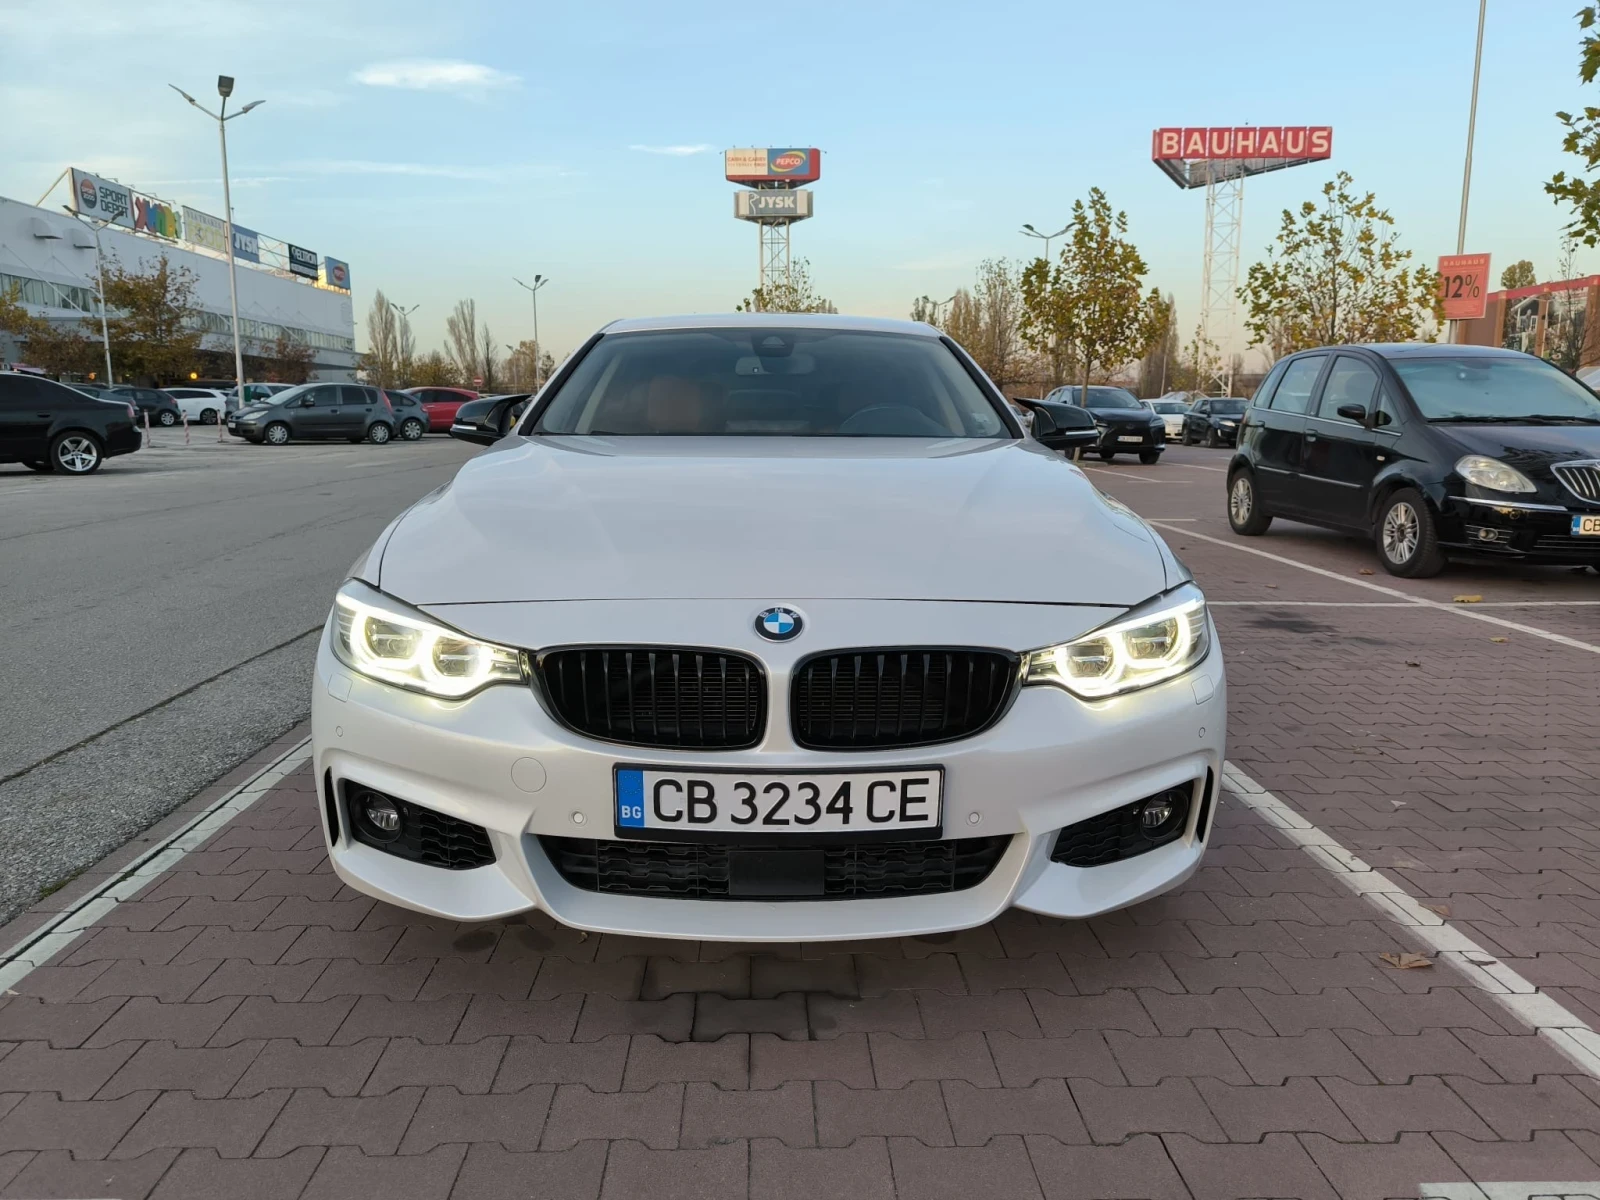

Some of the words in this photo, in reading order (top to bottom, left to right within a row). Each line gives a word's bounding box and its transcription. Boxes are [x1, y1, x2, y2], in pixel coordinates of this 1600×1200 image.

[1161, 130, 1329, 155] BAUHAUS
[775, 158, 801, 166] PEPCO
[99, 186, 127, 206] SPORT
[758, 196, 795, 209] JYSK
[233, 232, 259, 255] JYSK
[1443, 257, 1485, 267] BAUHAUS
[1444, 272, 1480, 299] 12%
[759, 607, 799, 618] BMW
[652, 778, 717, 824] CB
[730, 780, 853, 826] 3234
[866, 778, 930, 824] CE
[621, 805, 642, 820] BG
